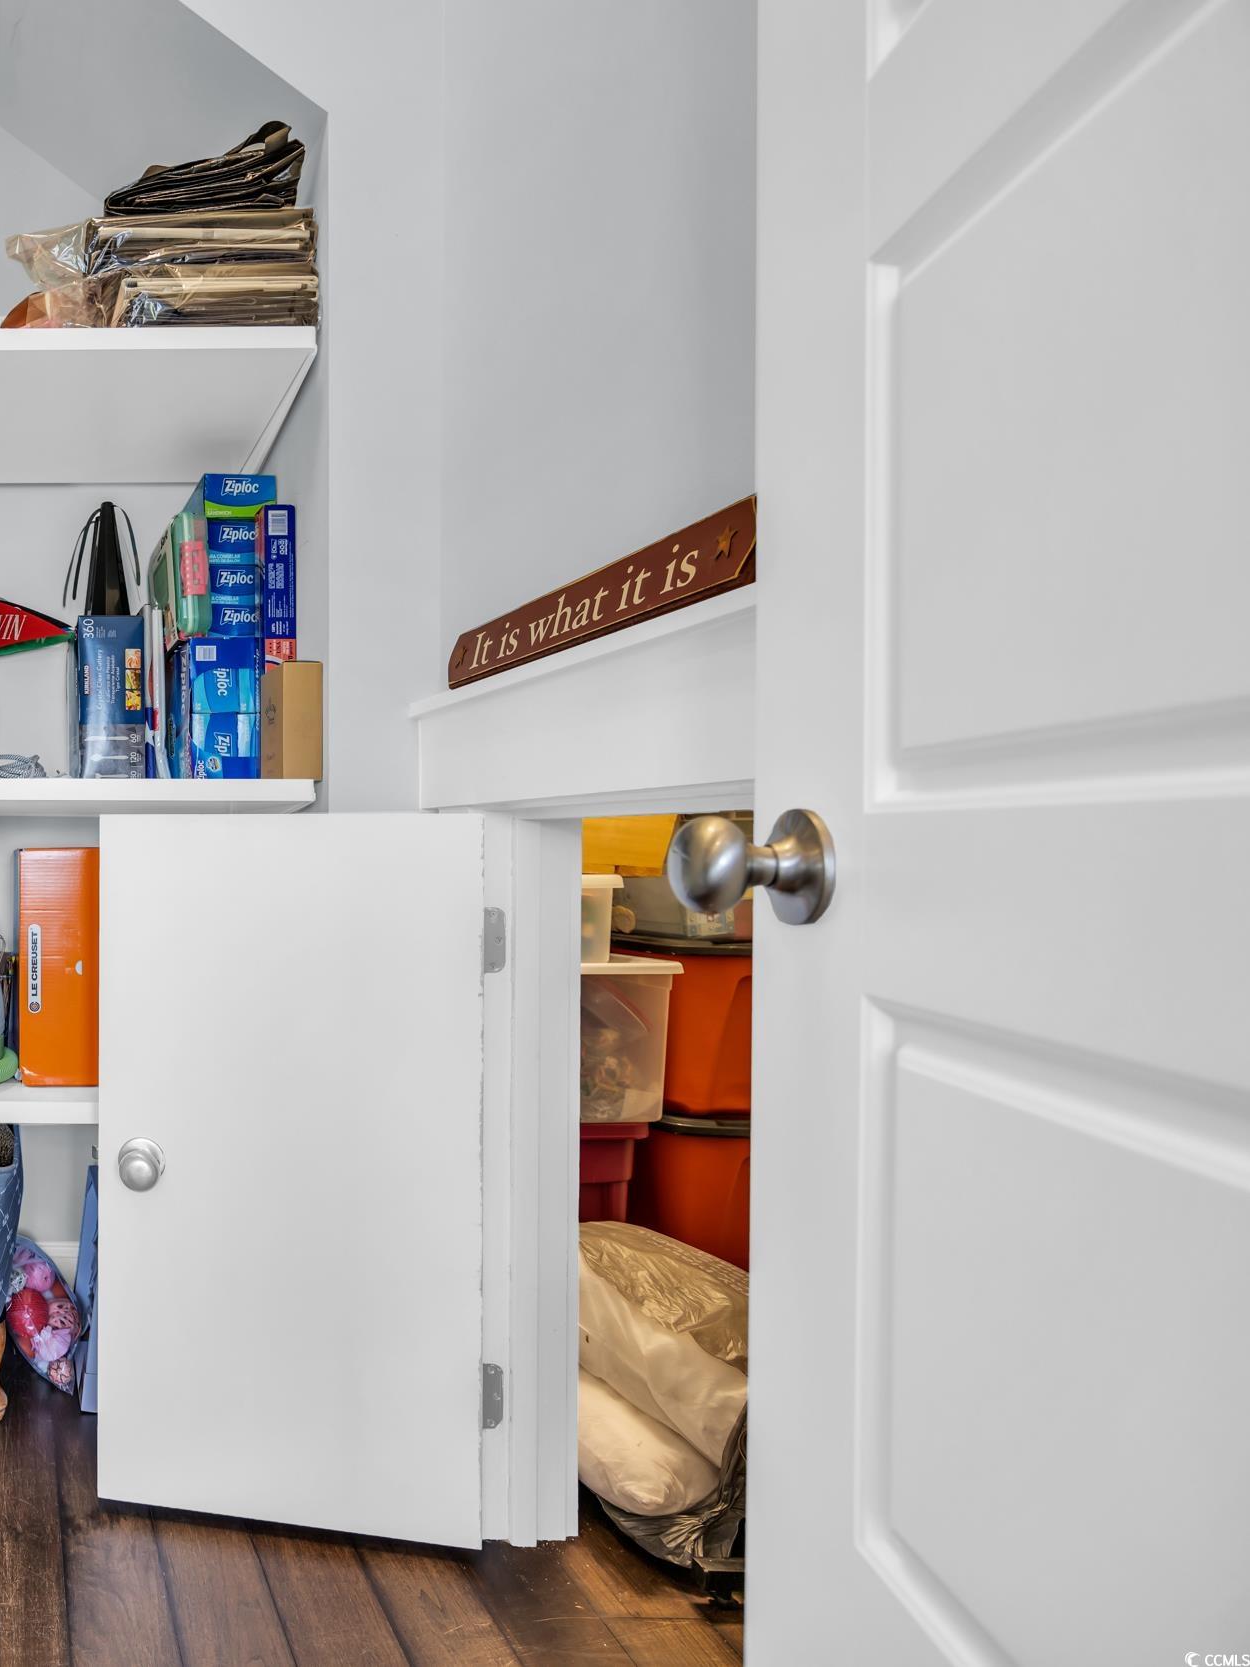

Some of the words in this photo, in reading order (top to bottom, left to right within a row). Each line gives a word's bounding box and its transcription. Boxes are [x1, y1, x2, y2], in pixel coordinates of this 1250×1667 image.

[224, 479, 260, 497] Ziploc
[222, 526, 255, 544] Ziploc
[220, 570, 254, 588] Ziploc
[469, 632, 493, 670] It
[497, 622, 520, 659] is
[528, 587, 609, 646] what
[615, 565, 652, 613] it
[659, 543, 699, 595] is
[223, 608, 257, 626] Ziploc
[83, 618, 94, 639] 360
[213, 668, 230, 696] iploc
[130, 733, 137, 744] 60
[213, 735, 230, 757] Zipl
[31, 983, 38, 997] LE
